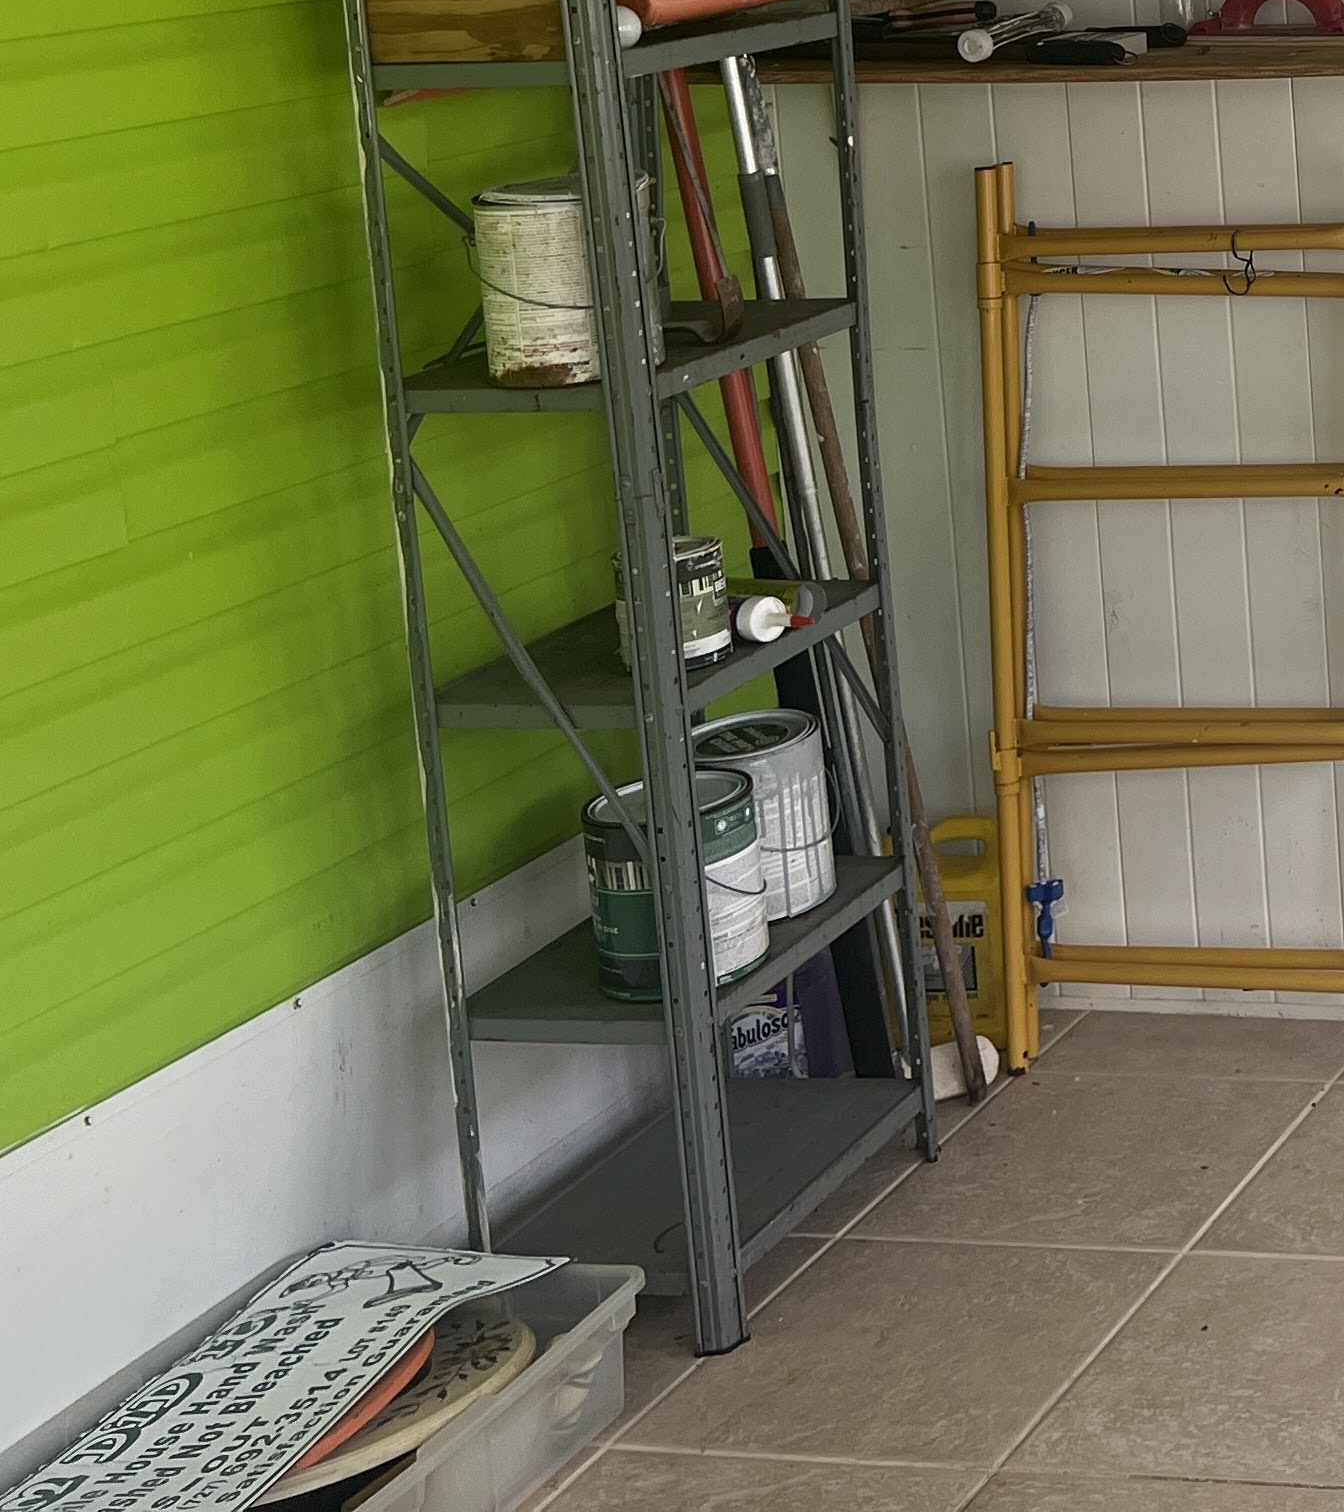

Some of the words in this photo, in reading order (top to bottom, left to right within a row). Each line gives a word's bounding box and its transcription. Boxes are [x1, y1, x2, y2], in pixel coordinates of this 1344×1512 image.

[94, 1422, 194, 1485] House
[178, 1361, 260, 1416] Hand
[242, 1304, 326, 1358] Wash
[168, 1421, 236, 1460] Not
[218, 1317, 345, 1415] Bleached
[175, 1479, 228, 1511] (727)
[219, 1368, 348, 1477] 692-3514
[338, 1338, 376, 1362] LOT
[215, 1374, 366, 1504] Satisfaction
